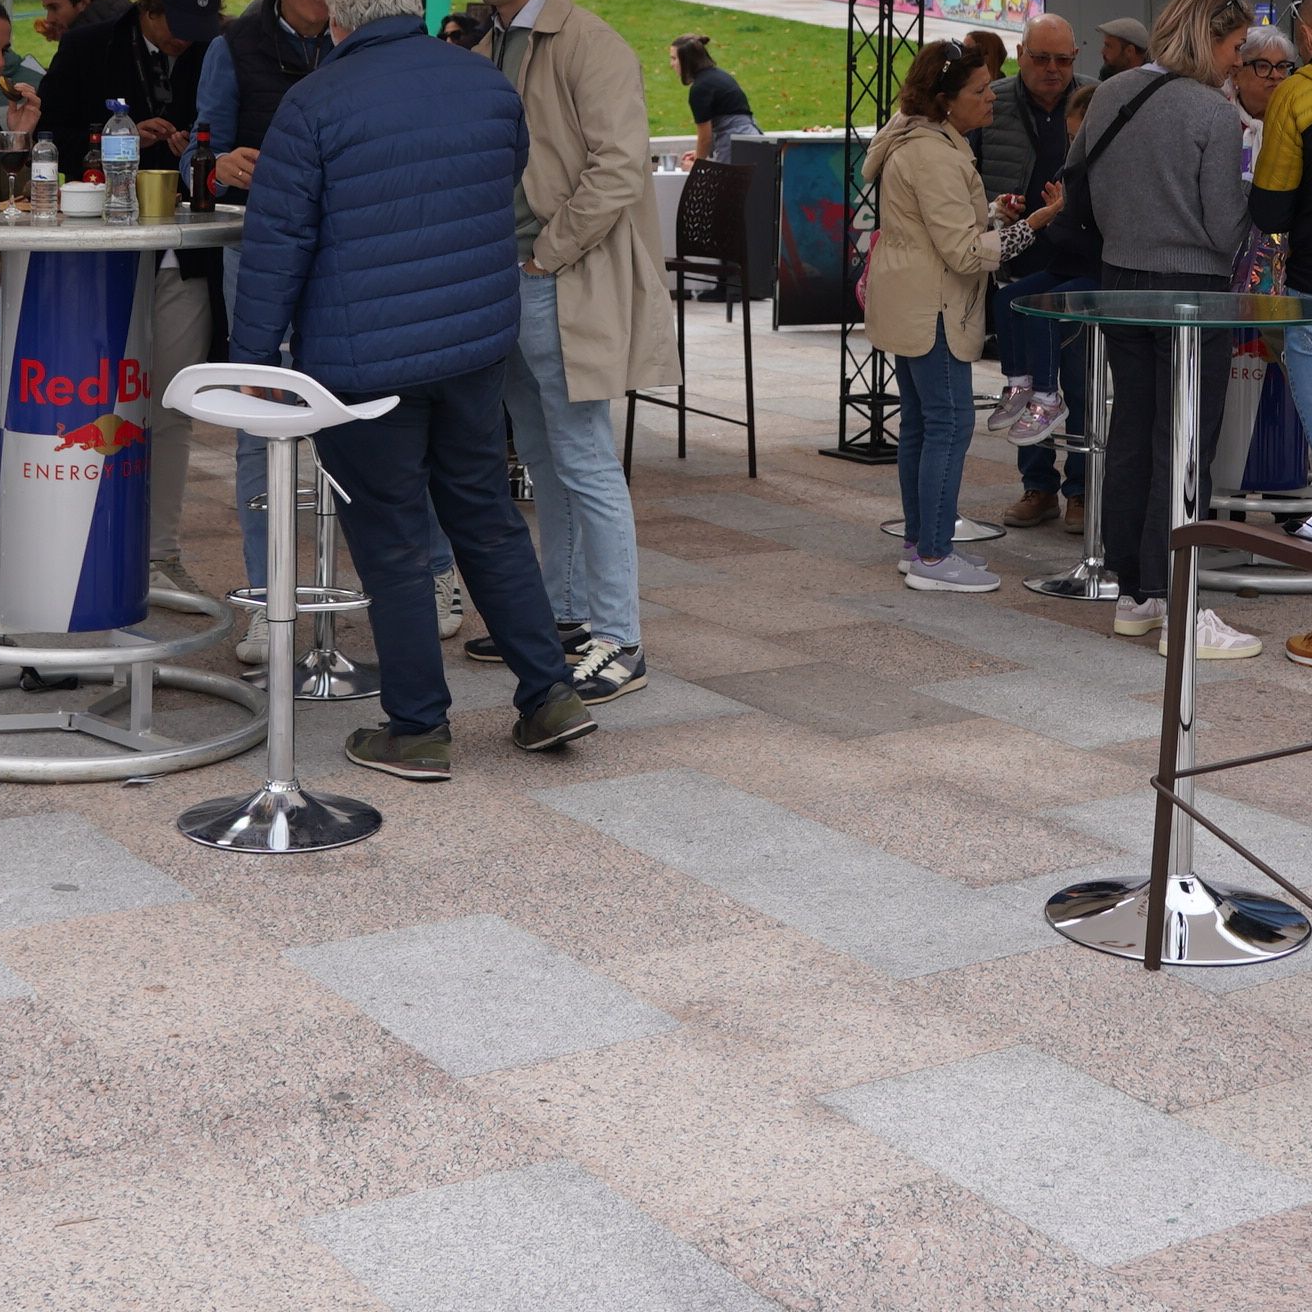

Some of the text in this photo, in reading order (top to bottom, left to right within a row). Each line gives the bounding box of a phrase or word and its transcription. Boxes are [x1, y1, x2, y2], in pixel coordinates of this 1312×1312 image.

[19, 358, 152, 406] Red Bu
[1231, 367, 1264, 381] ERG
[23, 462, 114, 481] ENERGY
